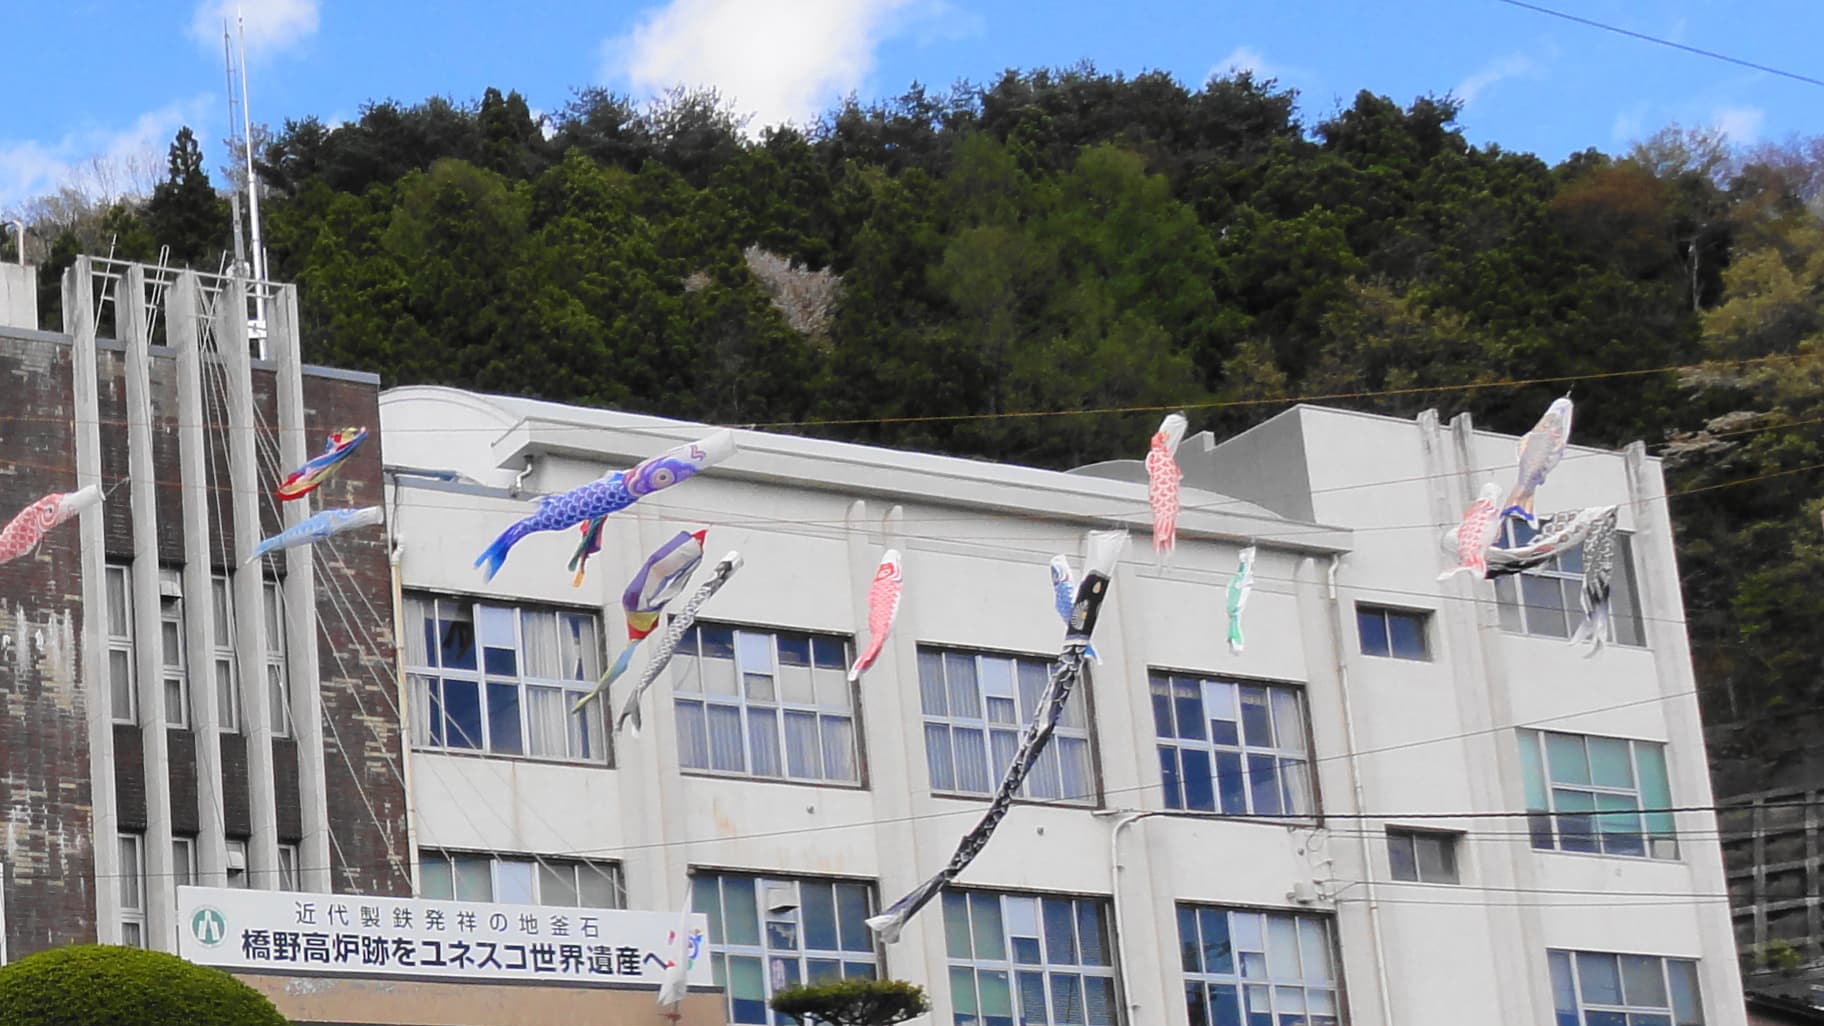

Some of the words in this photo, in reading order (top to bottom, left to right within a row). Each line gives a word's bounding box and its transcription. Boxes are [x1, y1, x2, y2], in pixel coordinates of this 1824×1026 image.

[242, 929, 667, 976] 橋野高炉跡をユネスコ世界遺産へ
